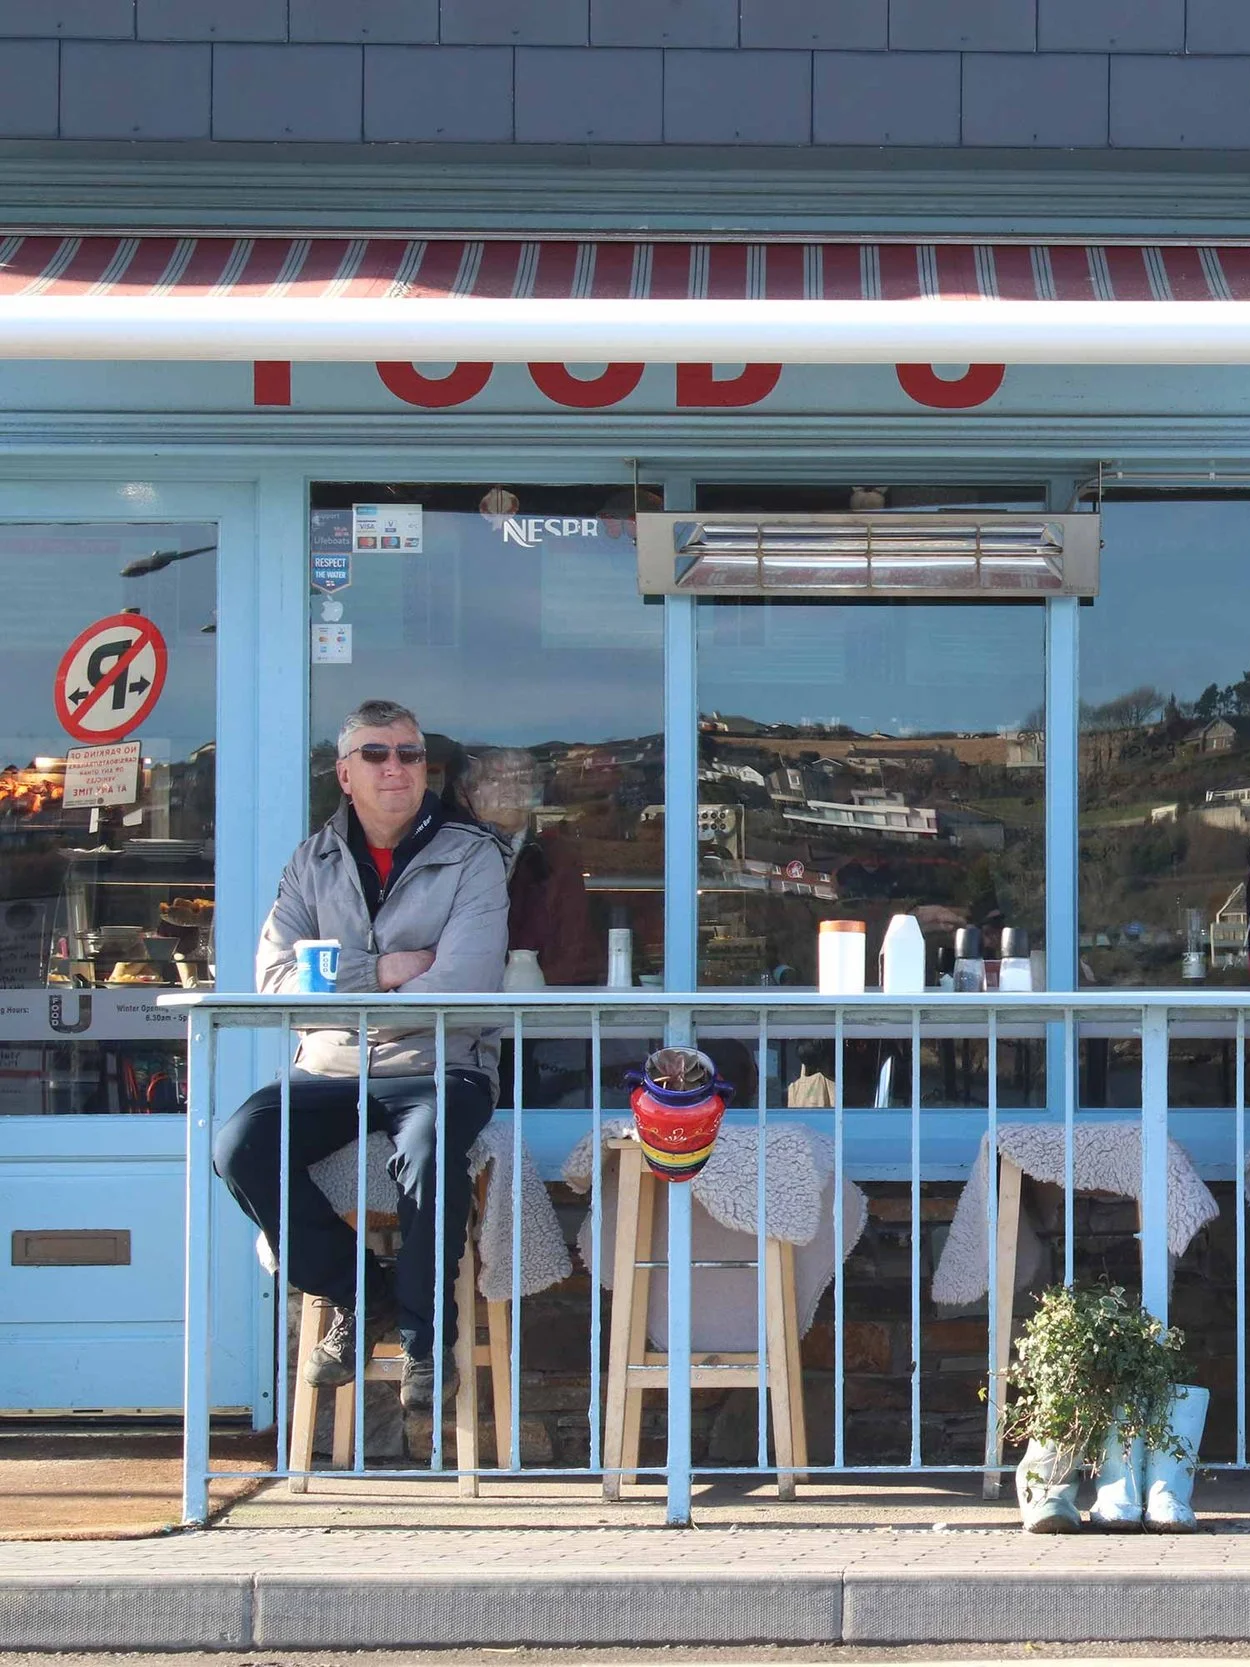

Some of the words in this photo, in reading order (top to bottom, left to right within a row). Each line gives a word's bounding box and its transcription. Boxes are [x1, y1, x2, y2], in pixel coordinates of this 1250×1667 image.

[314, 535, 350, 545] Lifeboats
[315, 558, 346, 568] RESPECT
[327, 570, 346, 578] WATER
[51, 997, 59, 1026] FOOD
[116, 1004, 140, 1012] Winter
